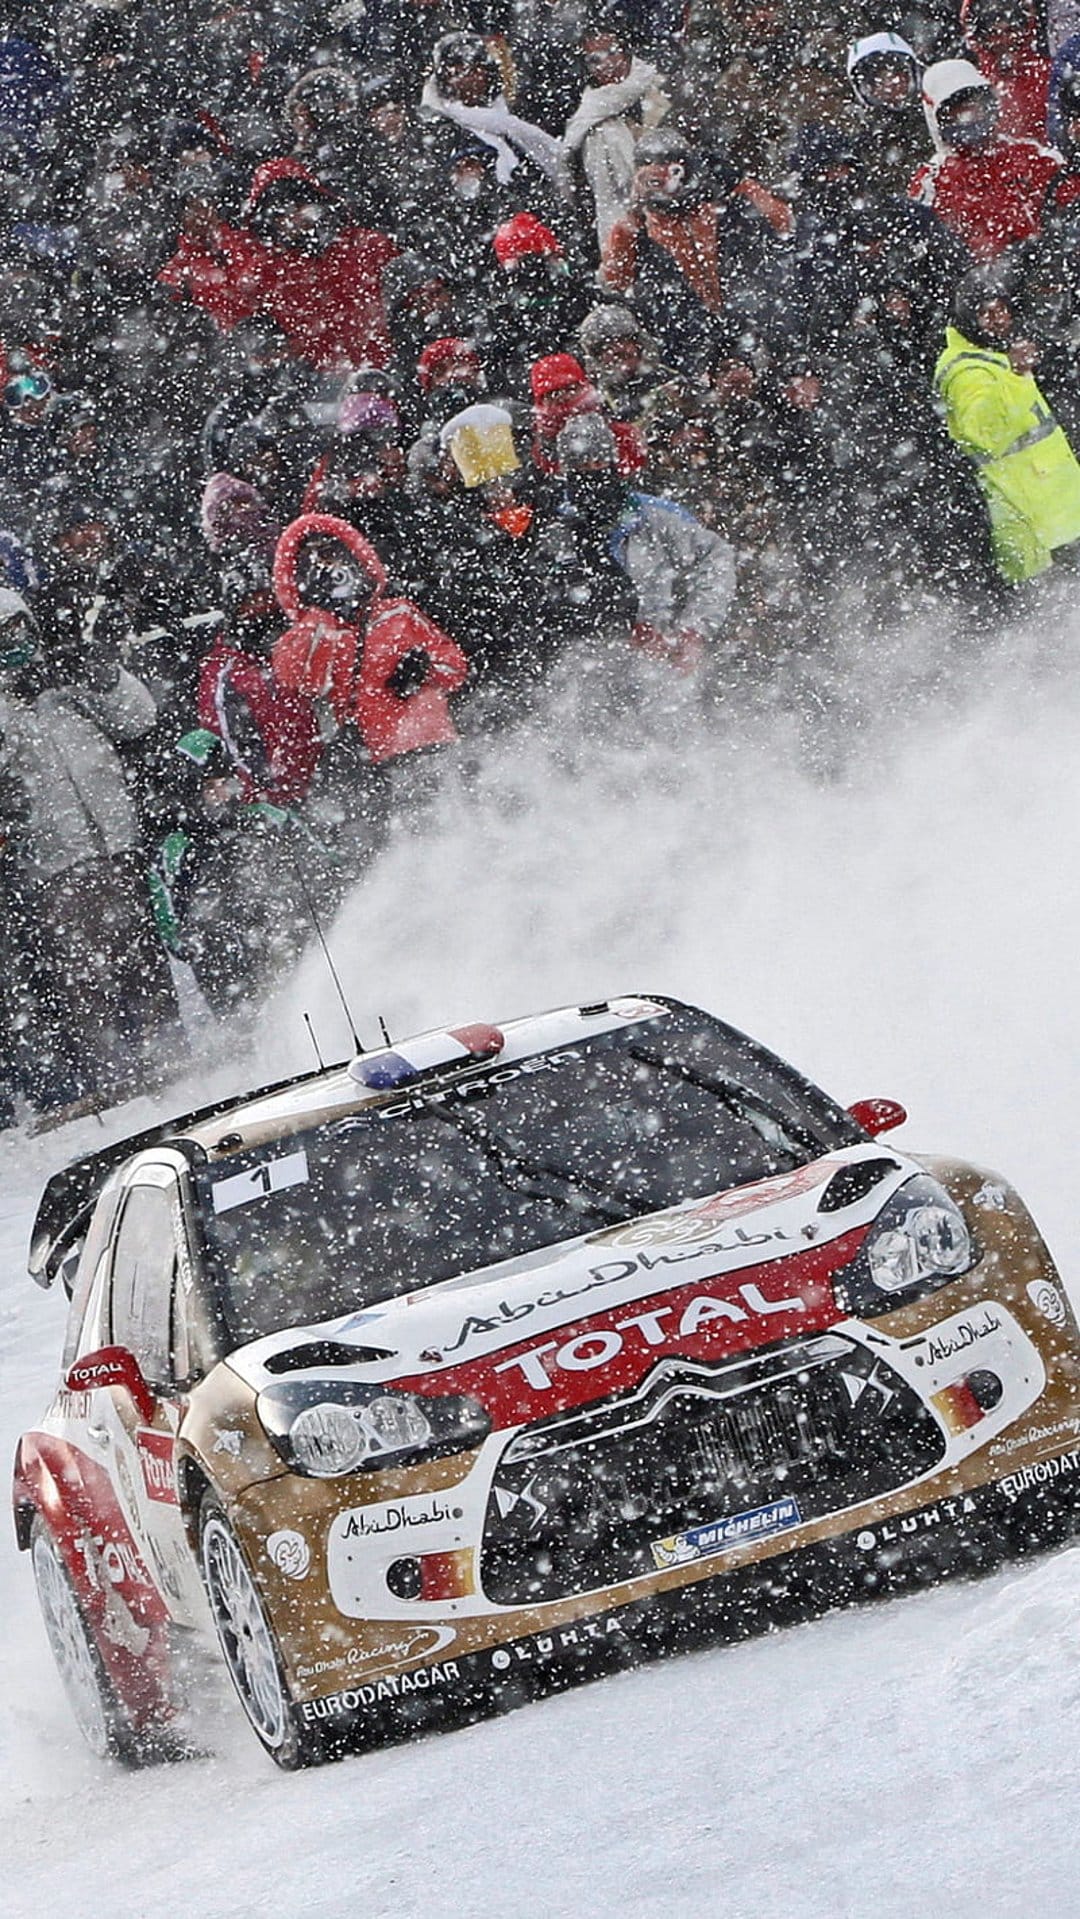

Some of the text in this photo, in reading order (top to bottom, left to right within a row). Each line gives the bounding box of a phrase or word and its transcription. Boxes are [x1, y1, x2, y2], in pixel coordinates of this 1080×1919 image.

[250, 1166, 271, 1192] 1
[494, 1284, 806, 1391] TOTAL
[72, 1362, 122, 1380] TOTAL
[1000, 1449, 1080, 1497] EURODAT
[698, 1504, 794, 1546] MICHELIN
[881, 1497, 977, 1541] LUHTA
[514, 1617, 622, 1660] LUHTA
[302, 1662, 461, 1722] EURODATACAR
